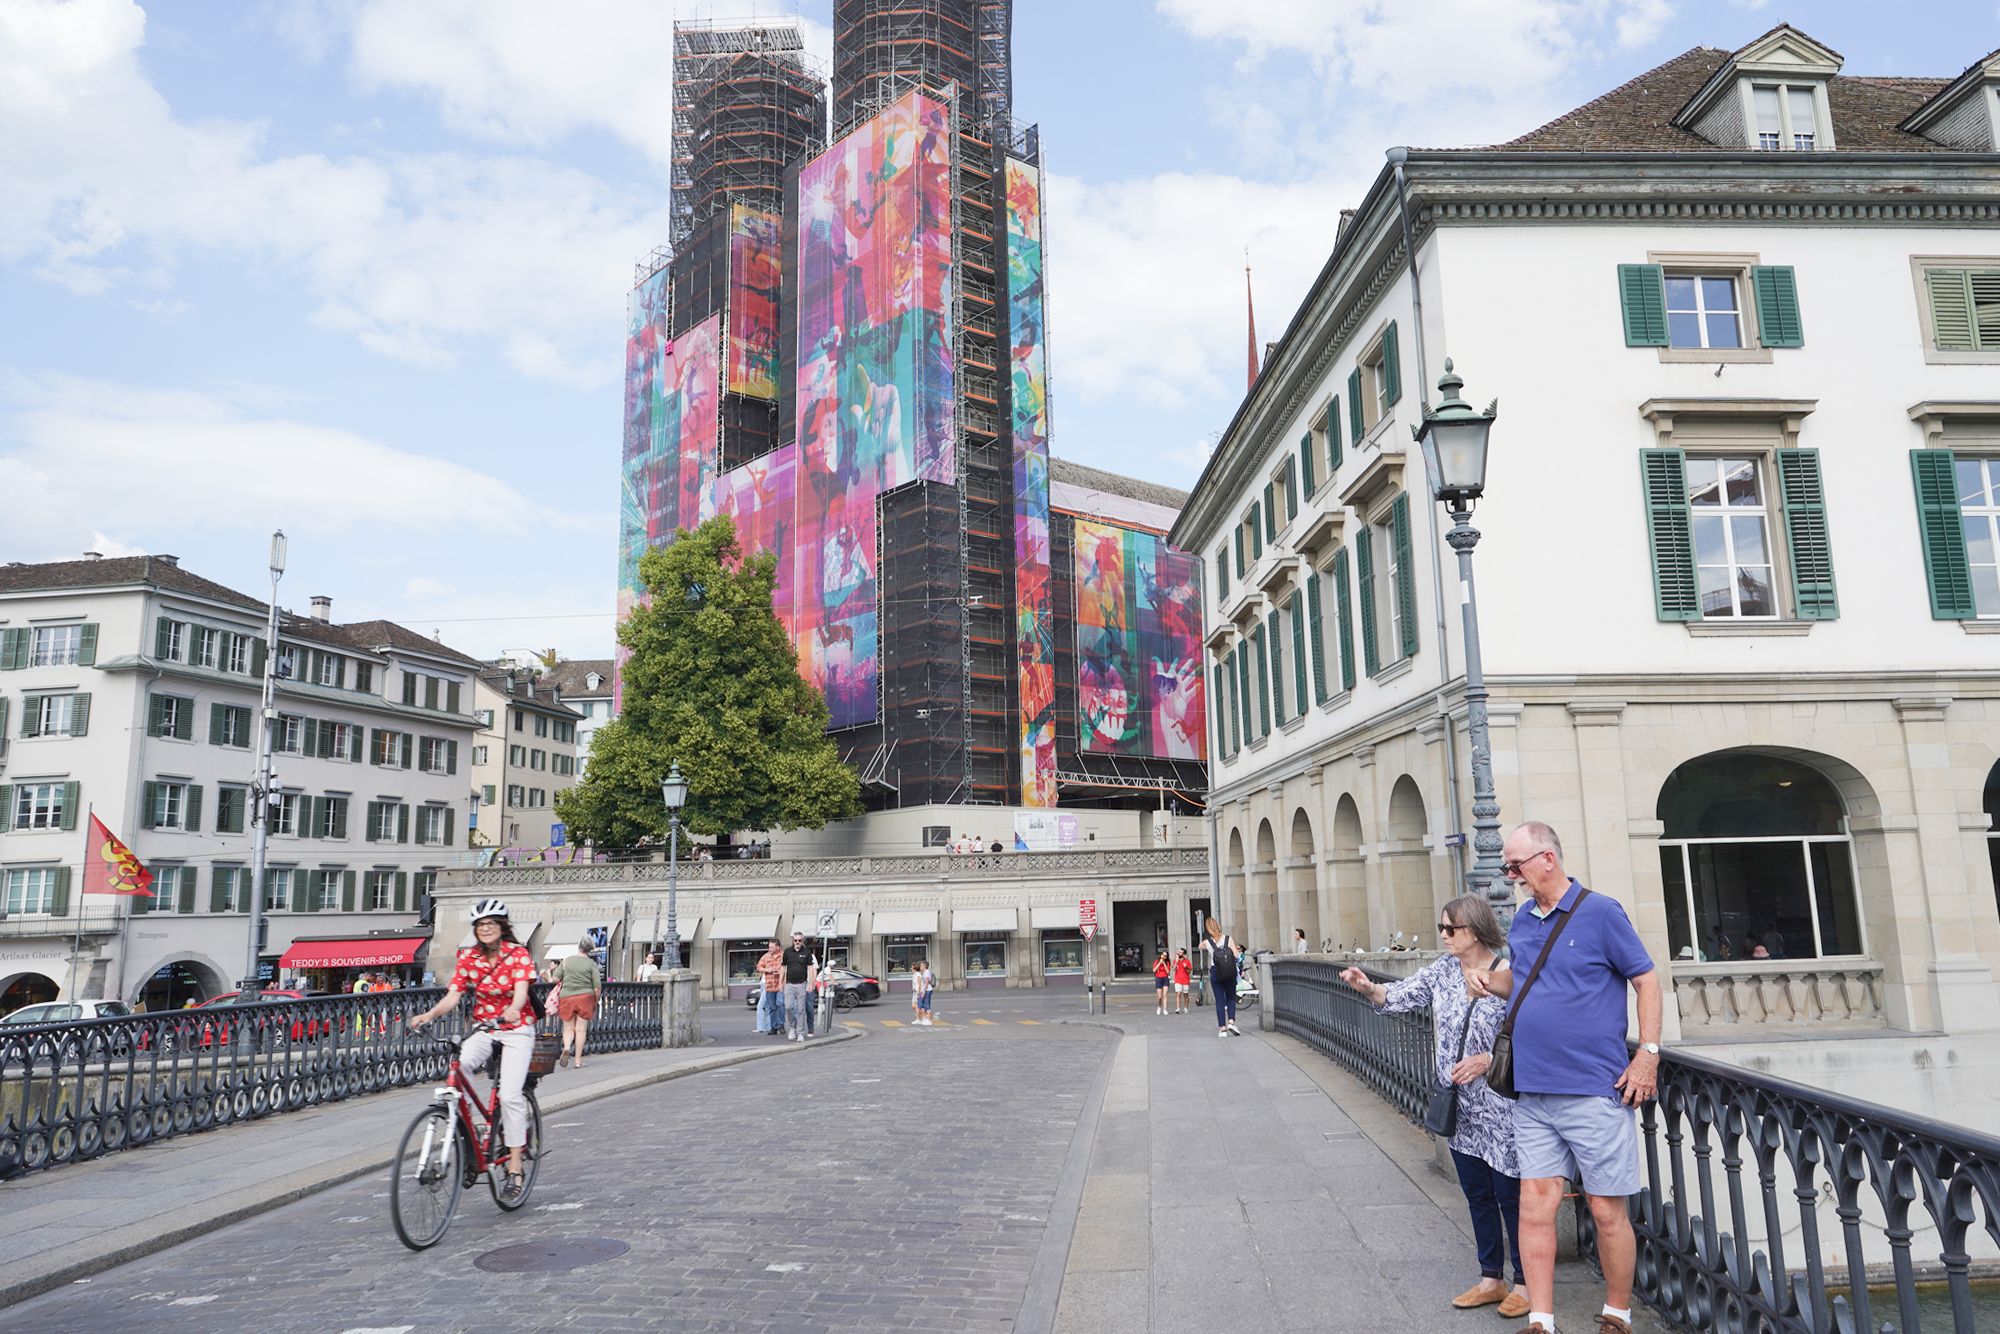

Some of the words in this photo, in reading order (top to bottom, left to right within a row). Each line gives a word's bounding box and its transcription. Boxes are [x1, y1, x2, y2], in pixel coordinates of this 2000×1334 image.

[0, 952, 30, 960] Artisan
[32, 950, 62, 960] Glacier
[331, 955, 403, 967] SOUVENIR-SHOP
